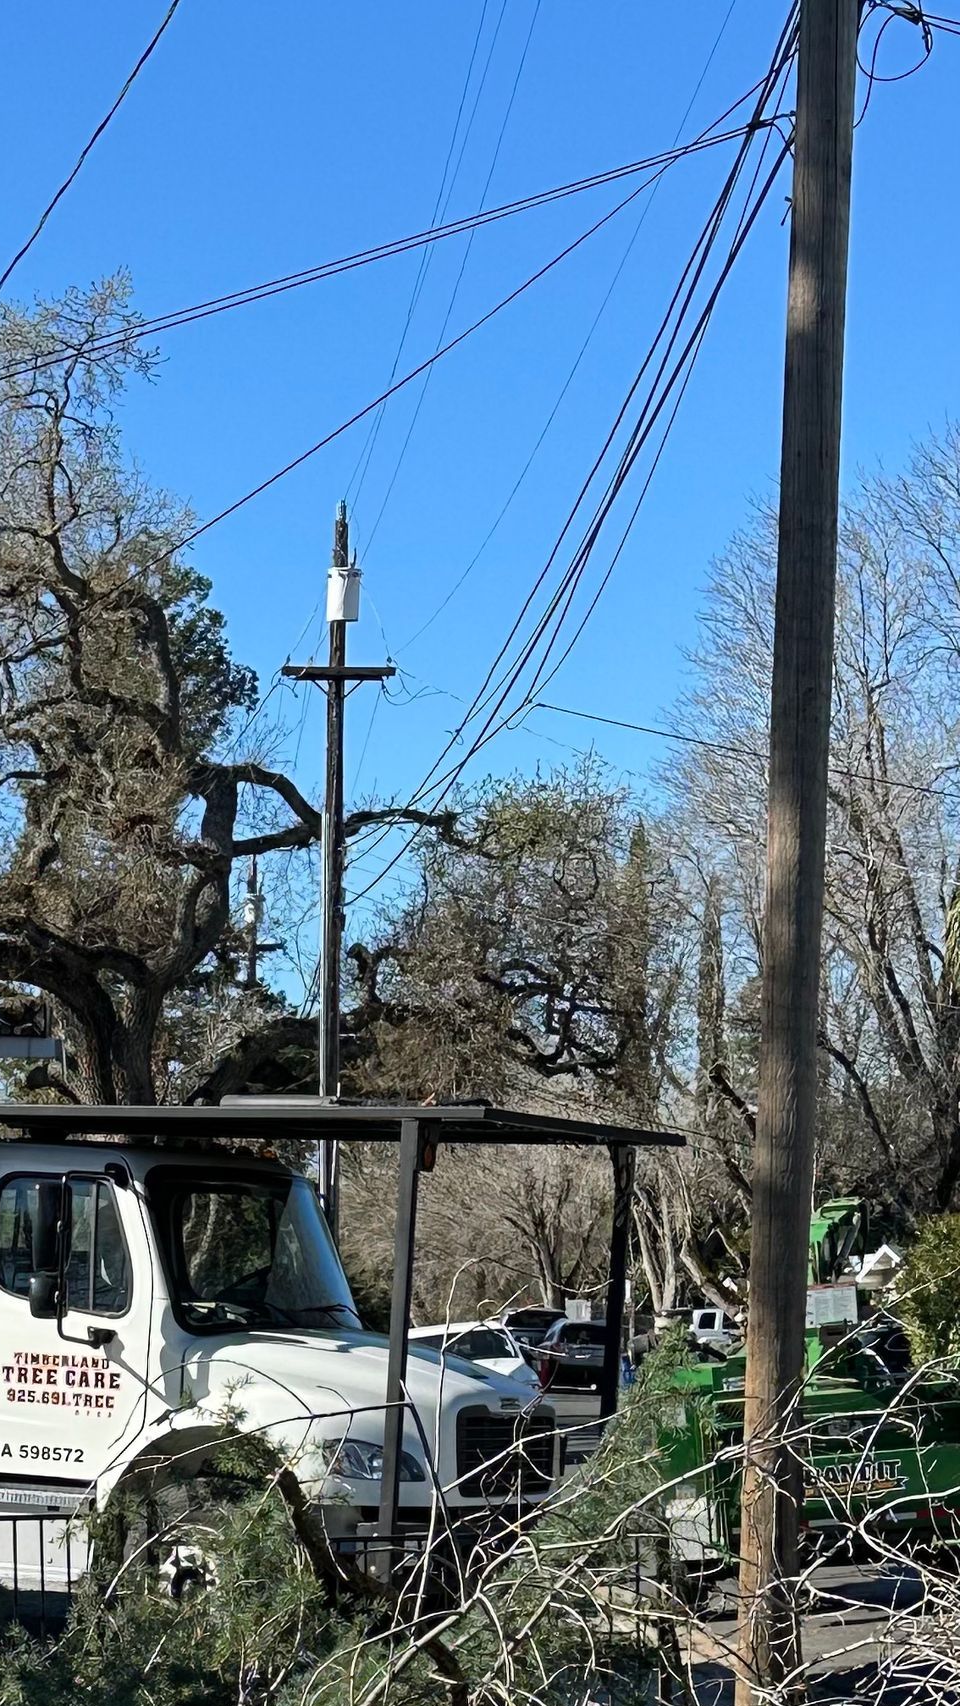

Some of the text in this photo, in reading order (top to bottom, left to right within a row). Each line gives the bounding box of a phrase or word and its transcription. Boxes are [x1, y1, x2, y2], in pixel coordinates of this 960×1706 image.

[14, 1352, 110, 1370] TIMBERLAND
[2, 1366, 121, 1389] TREE CARE
[7, 1388, 115, 1409] 925.691.TREE
[19, 1444, 84, 1463] 598572
